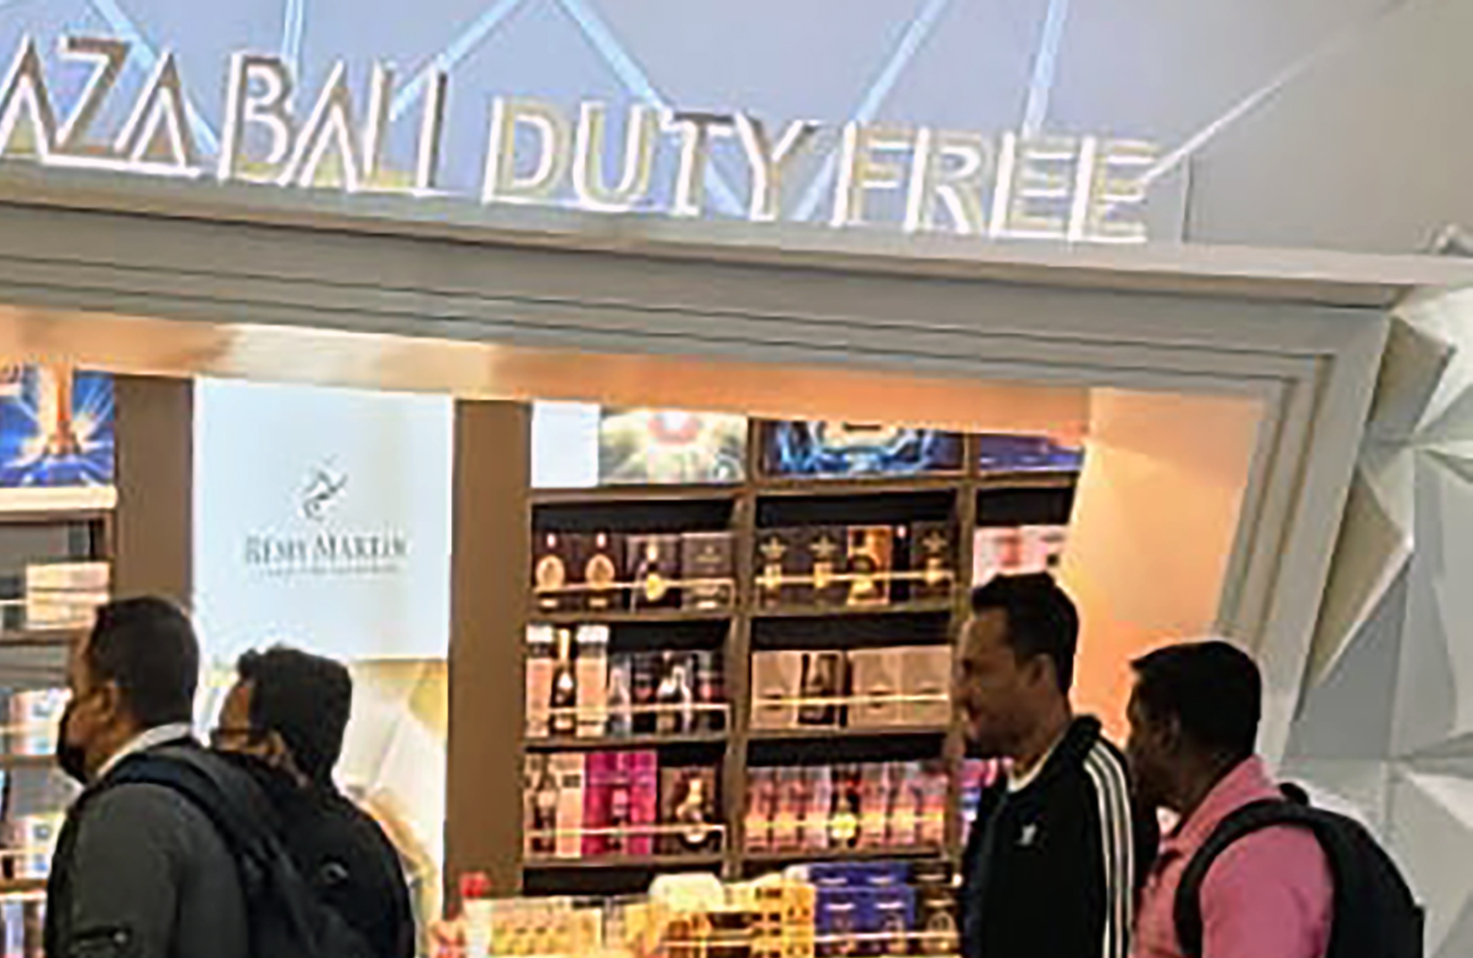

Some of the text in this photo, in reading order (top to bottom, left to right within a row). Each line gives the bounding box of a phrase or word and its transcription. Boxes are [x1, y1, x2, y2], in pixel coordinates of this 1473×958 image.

[217, 48, 451, 196] BALI
[482, 97, 820, 222] DUTY
[829, 118, 1159, 243] FREE
